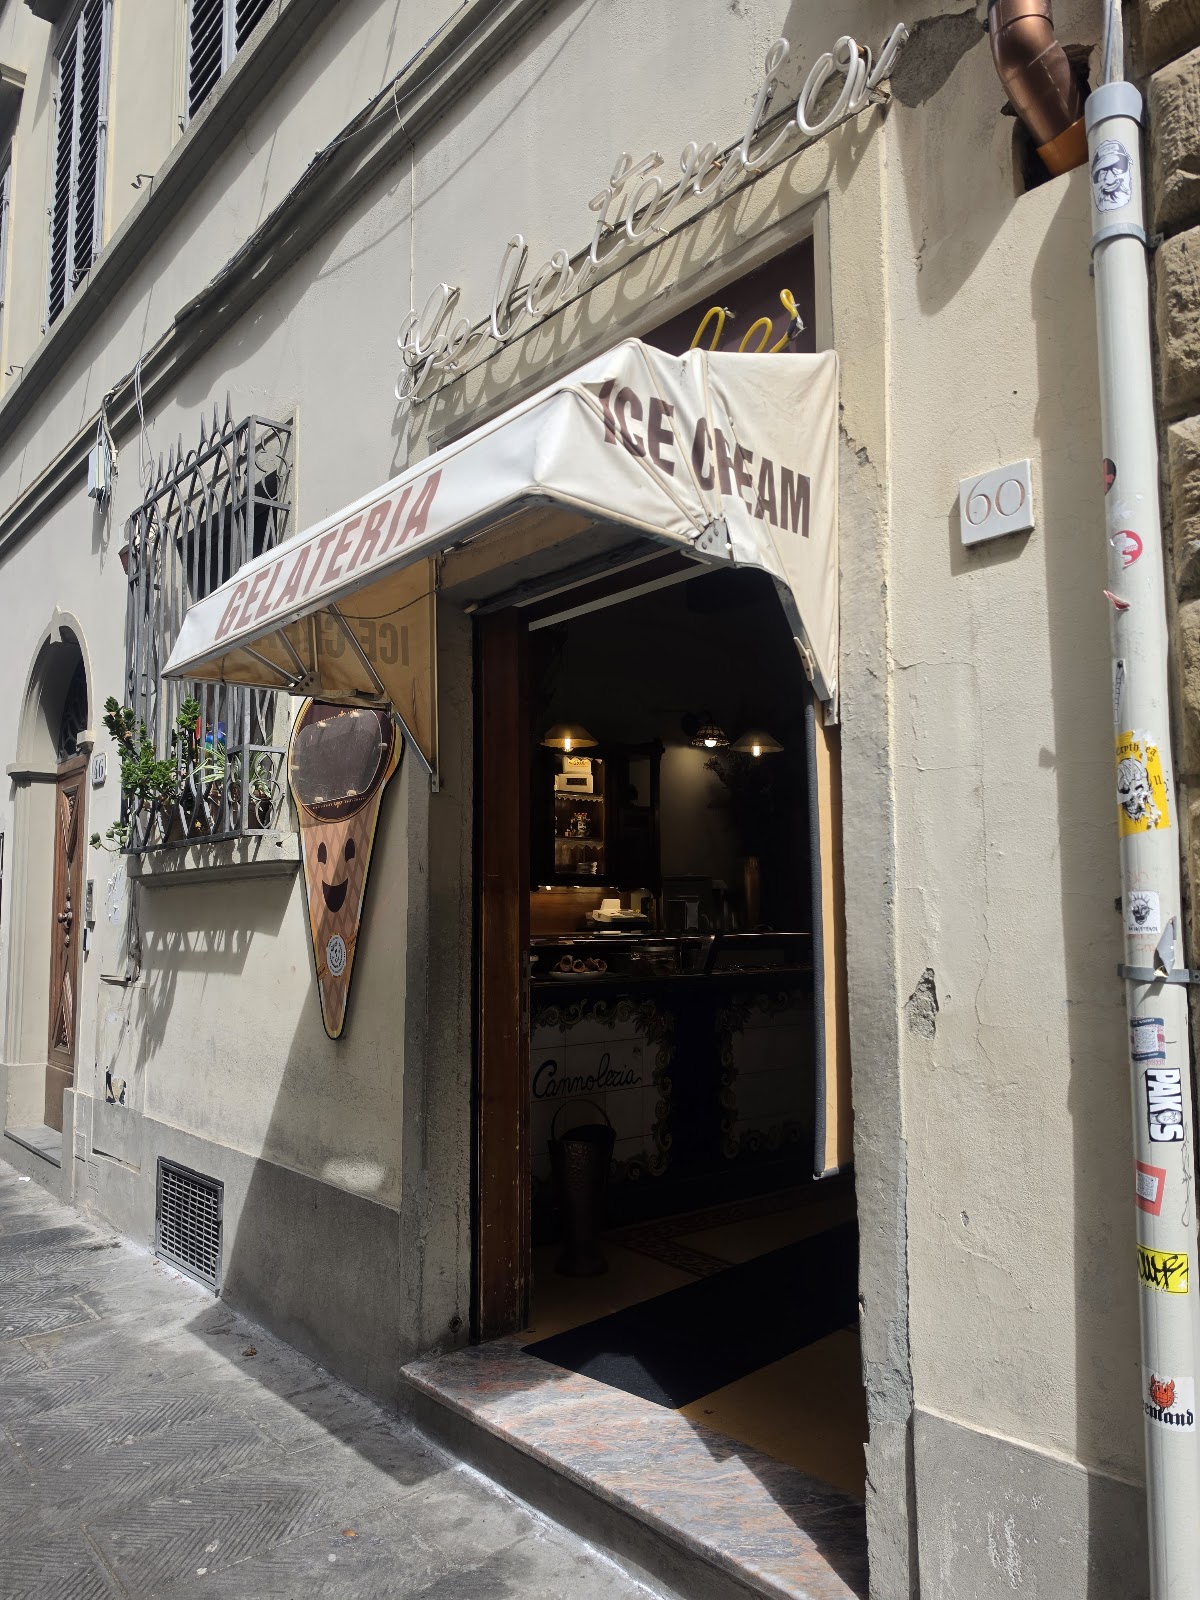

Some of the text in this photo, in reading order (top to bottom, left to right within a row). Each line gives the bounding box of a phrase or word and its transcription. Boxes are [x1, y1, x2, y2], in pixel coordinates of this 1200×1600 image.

[598, 377, 675, 477] ICE
[965, 475, 1026, 526] 60
[214, 468, 443, 641] GELATERIA
[532, 1052, 643, 1099] Cannoleria
